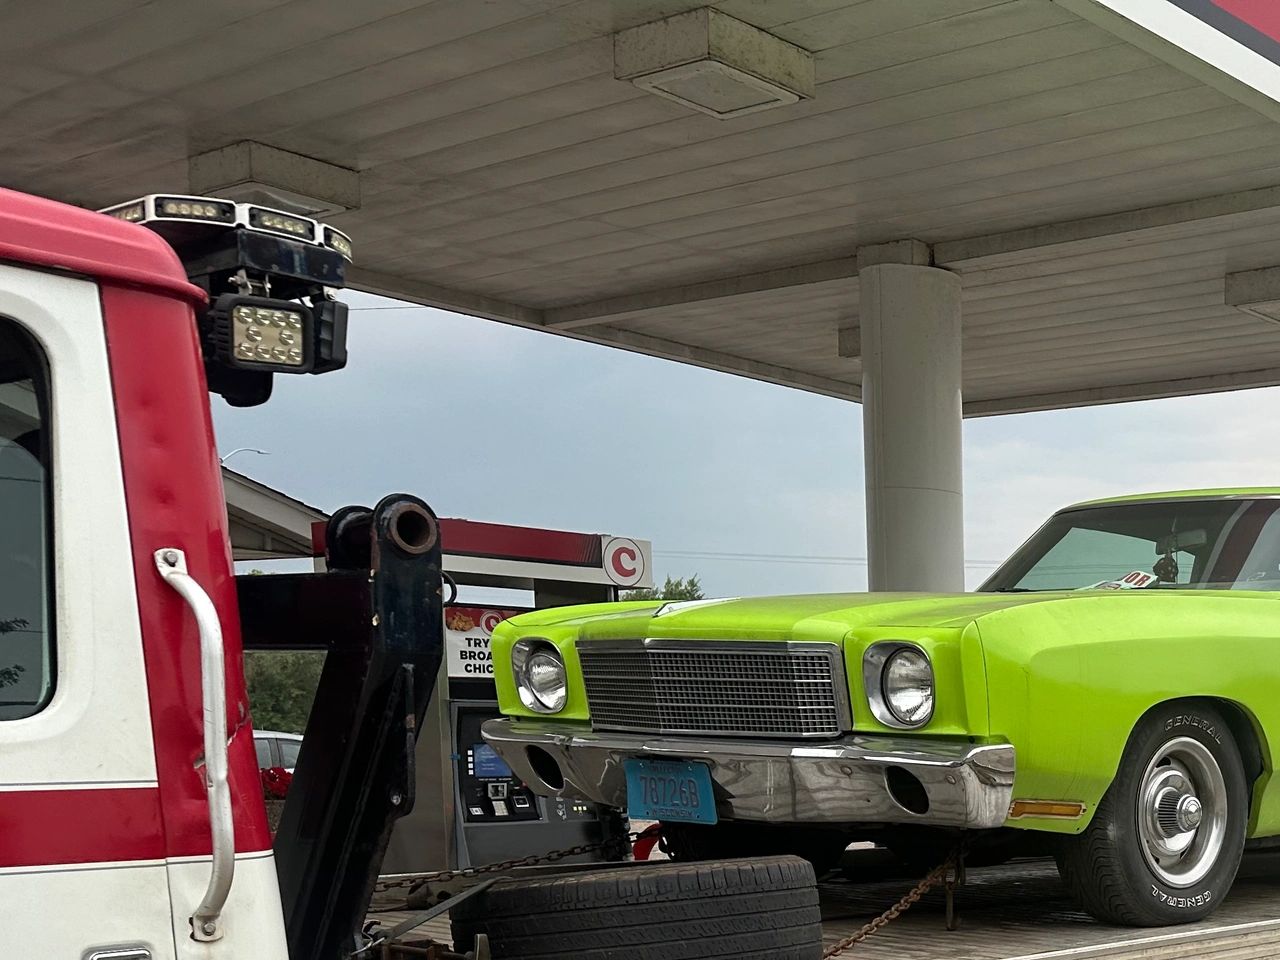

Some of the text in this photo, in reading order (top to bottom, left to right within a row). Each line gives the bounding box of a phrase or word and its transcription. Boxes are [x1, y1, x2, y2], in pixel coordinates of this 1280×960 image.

[611, 546, 637, 577] C
[465, 637, 490, 648] TRY
[1164, 714, 1222, 745] GENERAL
[1152, 884, 1212, 908] GENERAL
